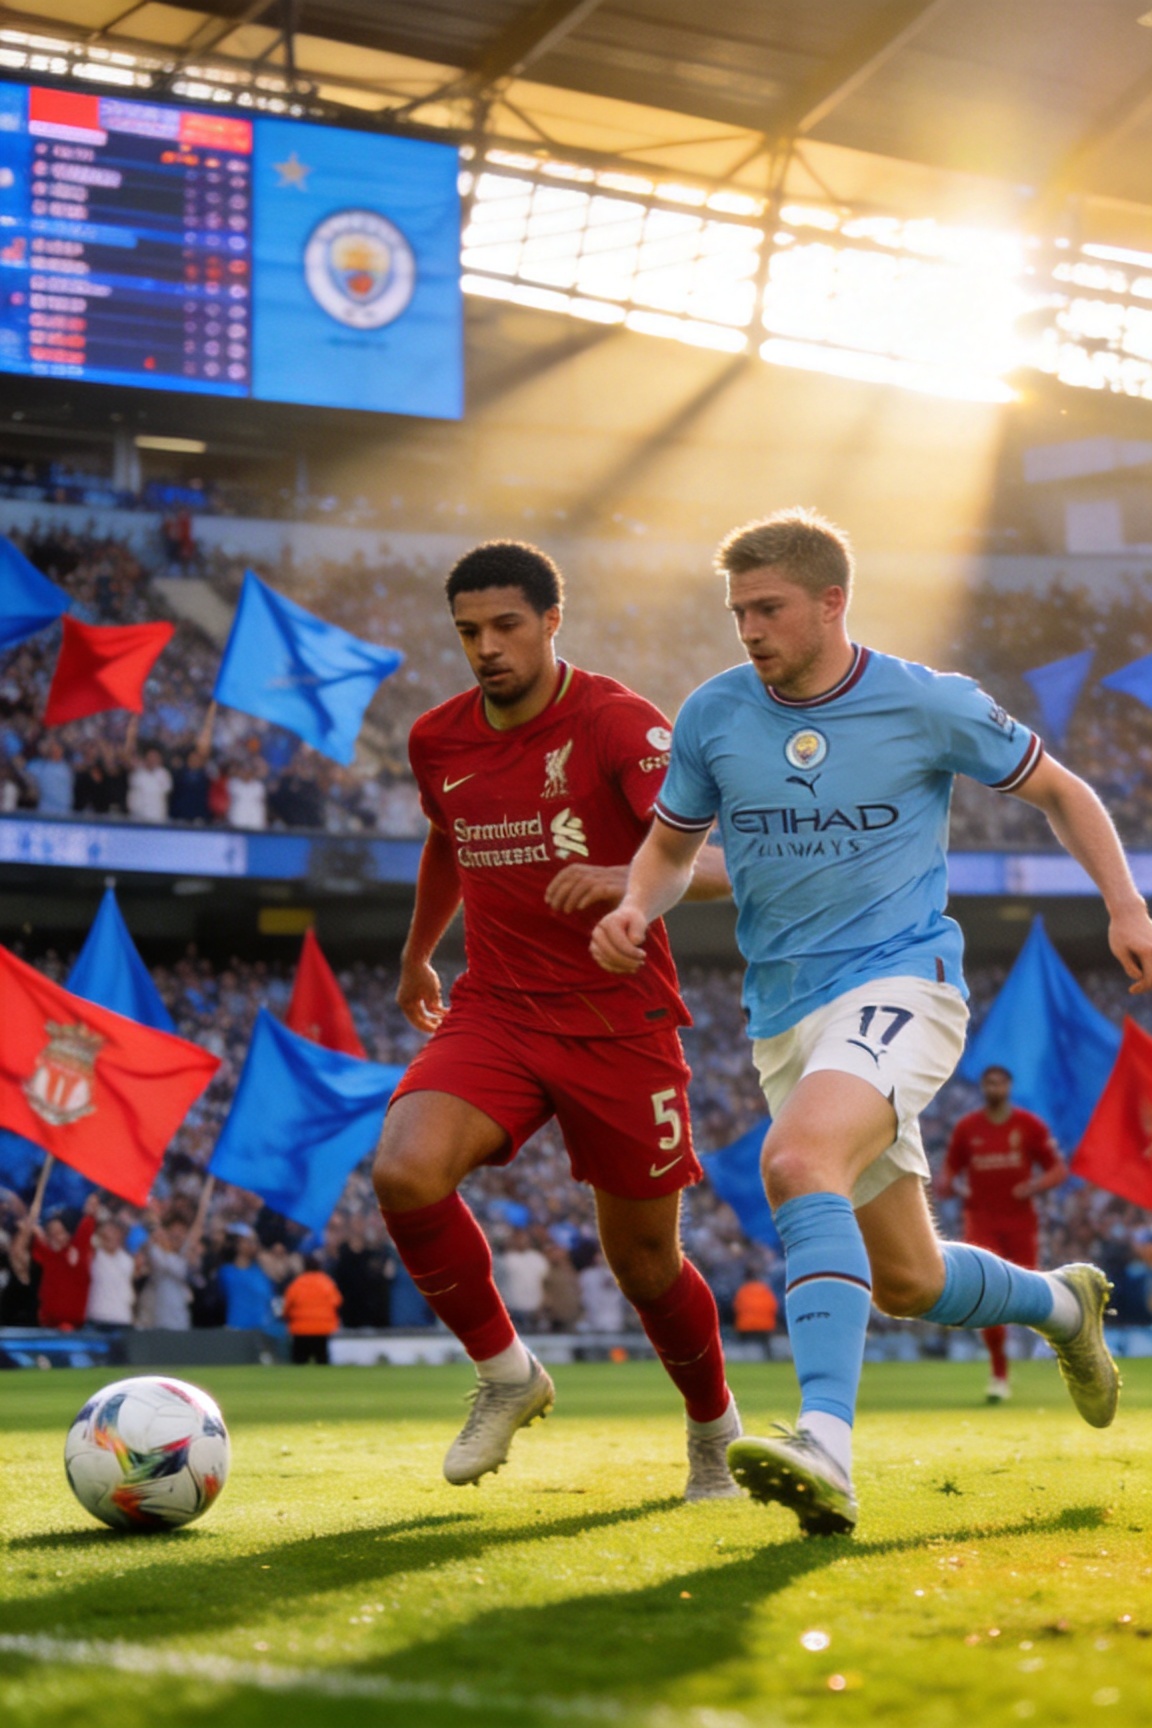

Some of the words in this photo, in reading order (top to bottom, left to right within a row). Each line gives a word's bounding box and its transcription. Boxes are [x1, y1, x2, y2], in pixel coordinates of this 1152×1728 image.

[731, 804, 899, 835] ETIHAD
[860, 1005, 914, 1046] 17
[651, 1088, 681, 1150] 5
